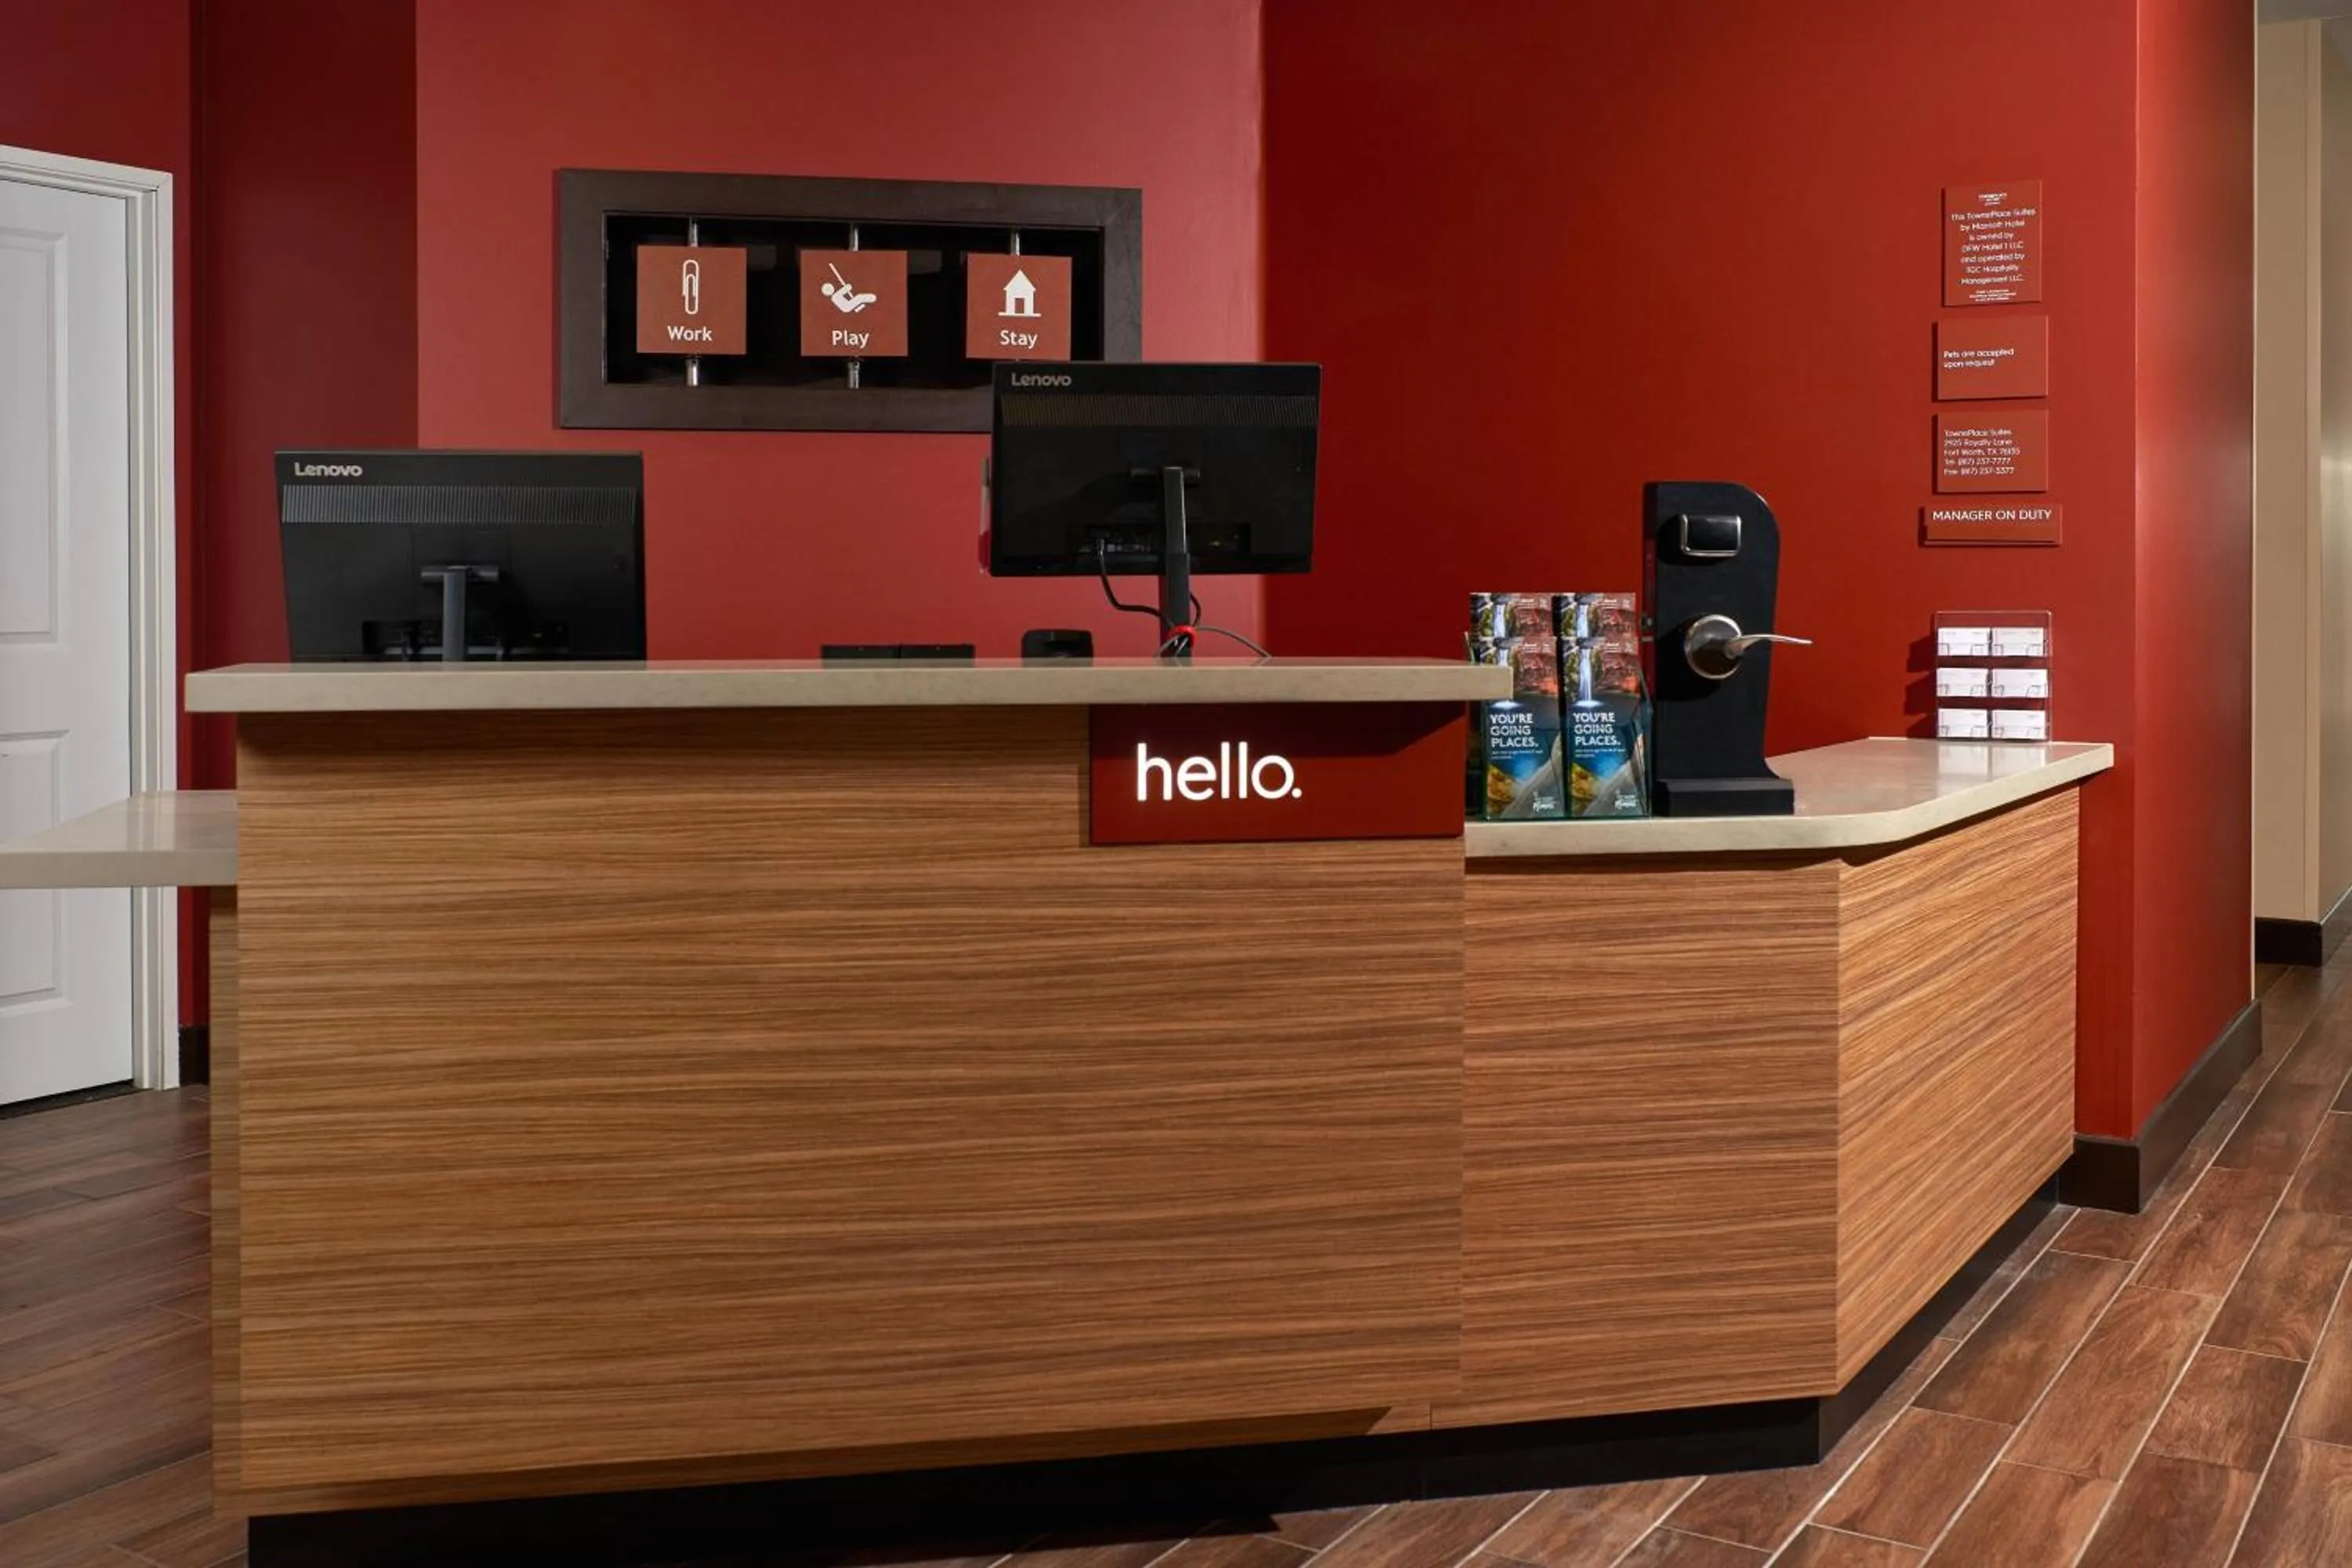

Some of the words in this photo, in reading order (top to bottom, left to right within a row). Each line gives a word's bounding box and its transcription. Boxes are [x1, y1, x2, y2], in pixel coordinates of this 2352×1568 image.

[1966, 210, 2012, 220] TownePlace
[2013, 208, 2037, 216] Suites
[1960, 223, 1970, 232] by
[1972, 221, 2003, 230] Marriott
[2005, 220, 2025, 228] Hotel
[1976, 232, 2003, 241] owned
[2004, 232, 2014, 241] by
[1981, 242, 2003, 251] Hotel
[1961, 255, 1976, 263] and
[1977, 252, 2013, 263] operated
[2014, 252, 2025, 261] by
[1983, 264, 2020, 273] Hospitality
[1961, 275, 2008, 285] Management
[668, 326, 712, 340] Work
[833, 330, 869, 348] Play
[1001, 330, 1037, 349] Stay
[1976, 348, 2014, 358] accepted
[1965, 358, 1995, 368] request
[1012, 373, 1071, 386] Lenovo
[1989, 428, 2013, 437] Suites
[1944, 448, 1959, 456] Fort
[1961, 448, 1985, 456] Worth,
[1987, 447, 1998, 456] TX
[295, 463, 362, 476] Lenovo
[1933, 510, 1992, 521] MANAGER
[1995, 510, 2016, 521] ON
[2019, 509, 2053, 521] DUTY
[1490, 713, 1534, 724] YOU'RE
[1573, 712, 1616, 724] YOU'RE
[1490, 725, 1531, 736] GOING
[1574, 724, 1613, 735] GOING
[1491, 737, 1539, 748] PLACES.
[1575, 735, 1621, 746] PLACES.
[1138, 742, 1301, 800] hello.
